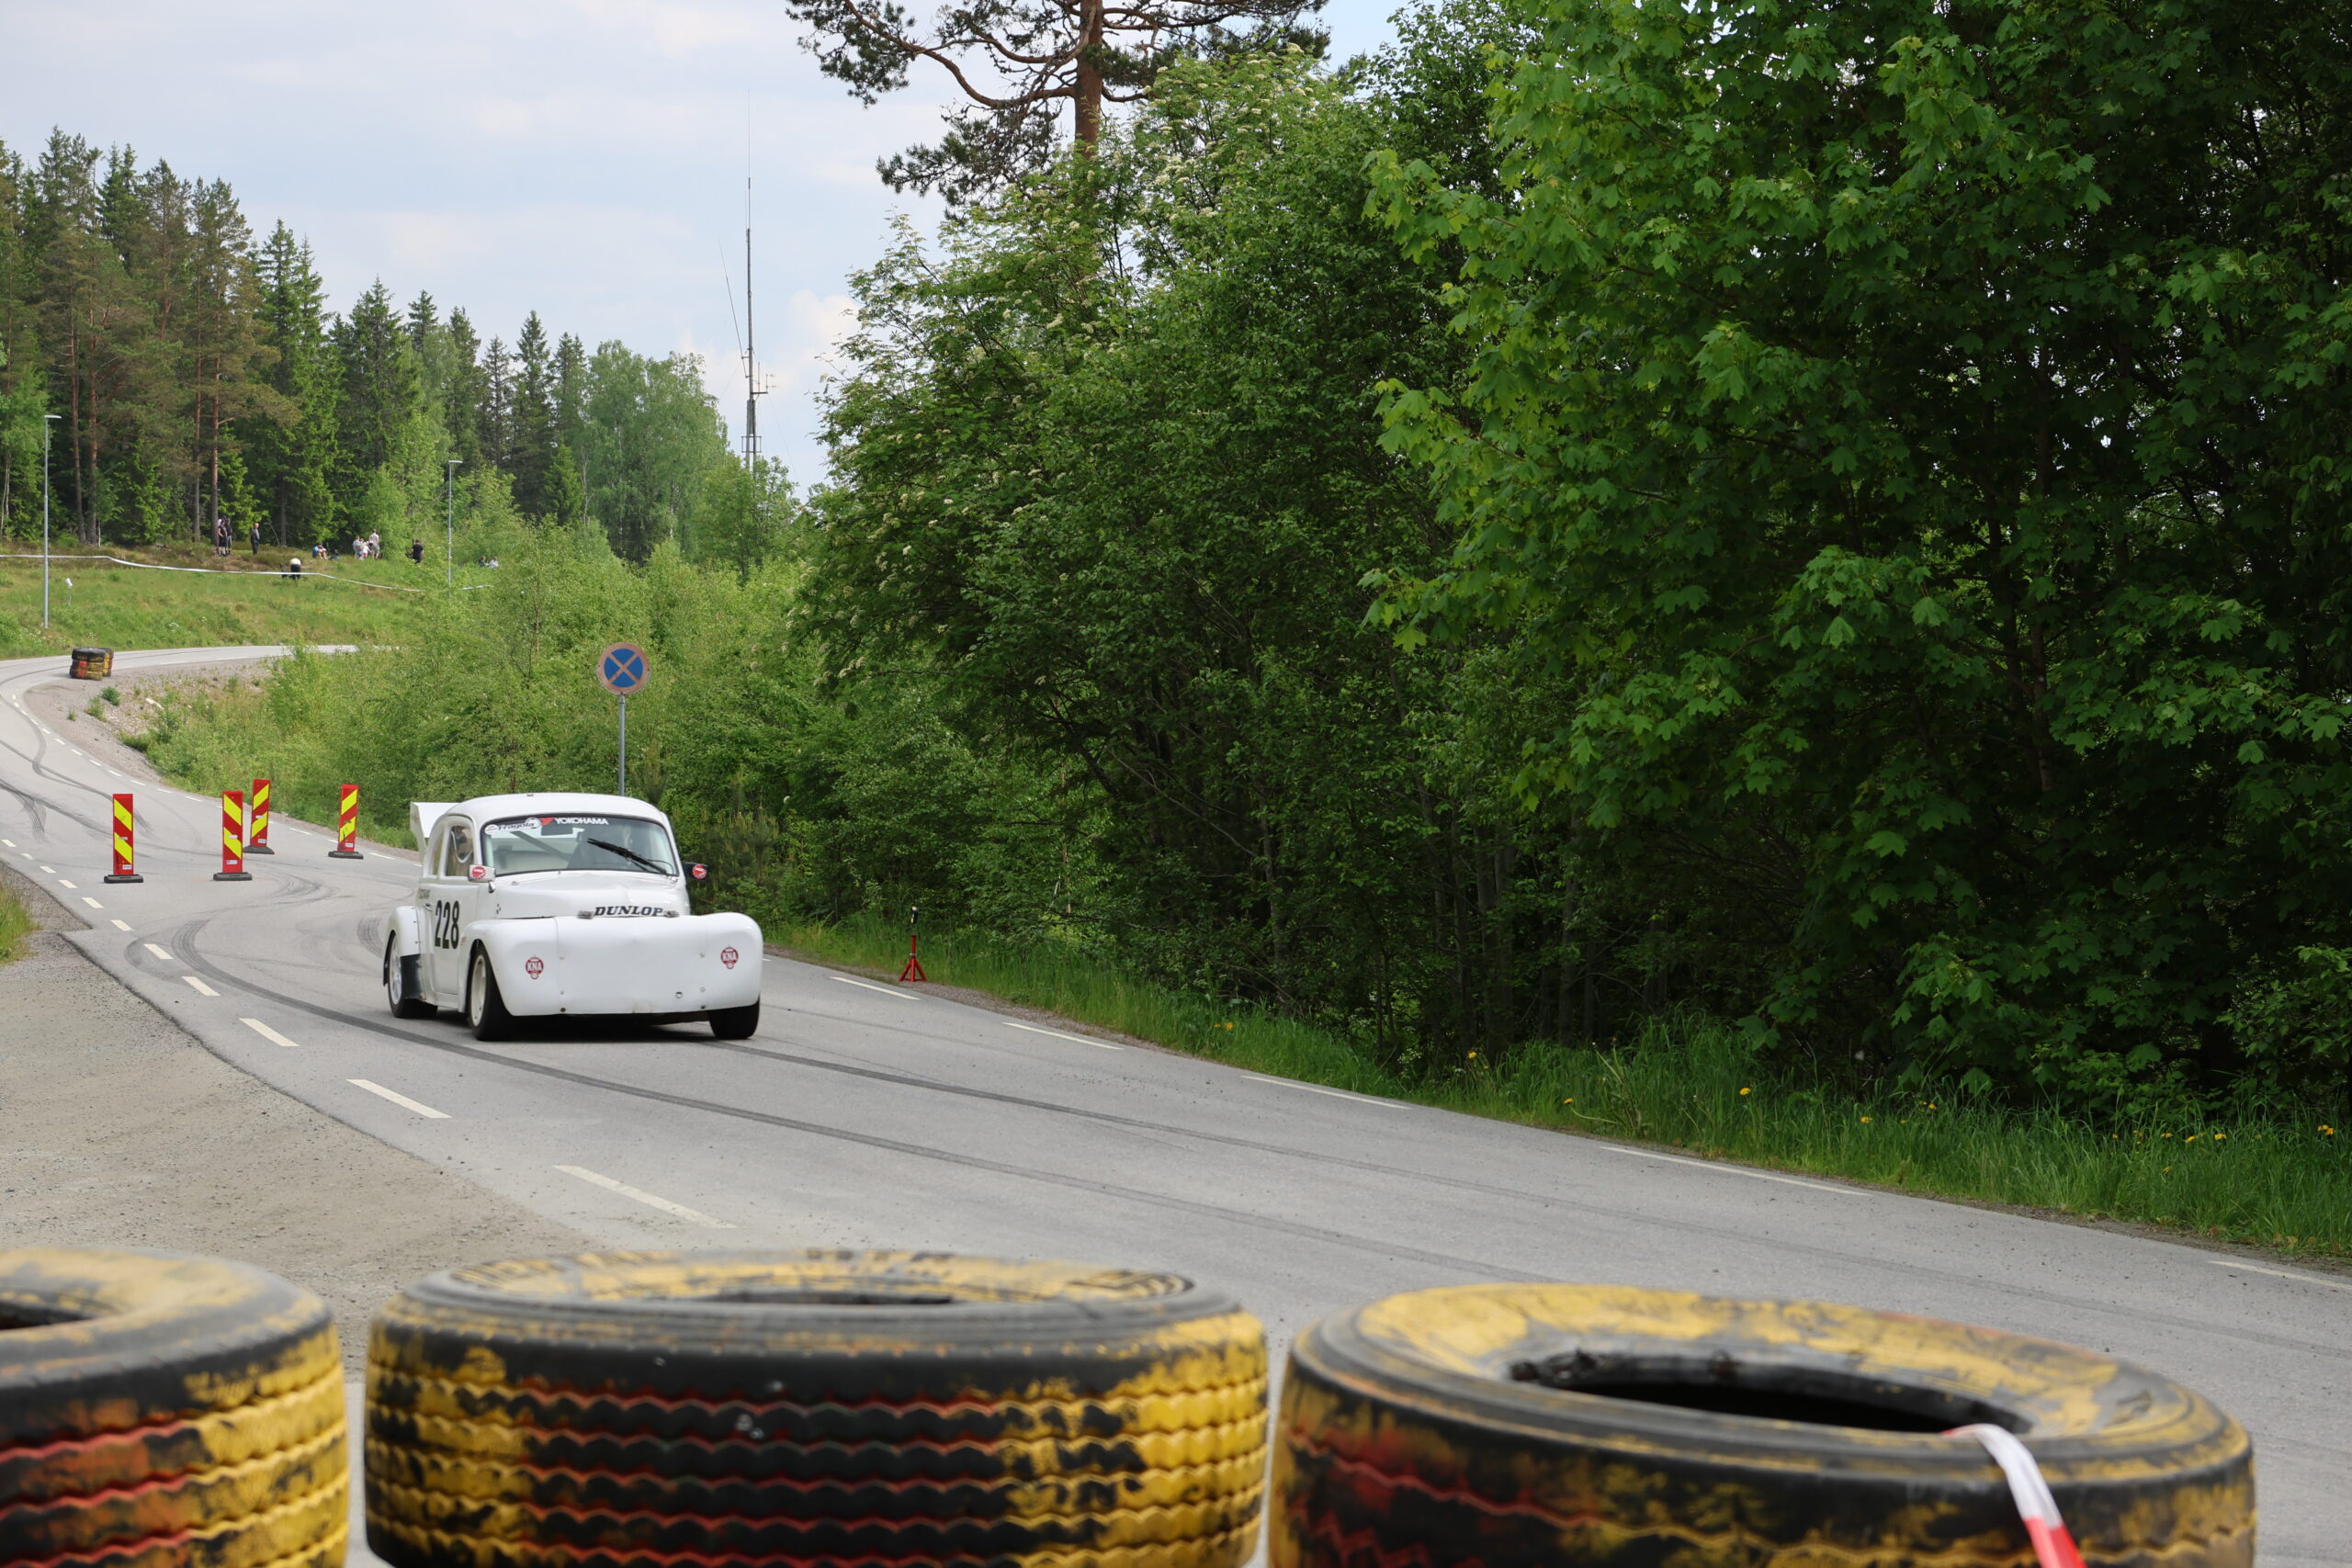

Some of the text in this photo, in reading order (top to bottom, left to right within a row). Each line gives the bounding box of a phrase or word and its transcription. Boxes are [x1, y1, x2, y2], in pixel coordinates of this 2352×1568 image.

[499, 821, 535, 830] Fragola
[554, 817, 609, 825] YOKOHAMA
[594, 905, 663, 917] DUNLOP
[435, 900, 460, 950] 228
[723, 952, 737, 962] KNA
[527, 962, 542, 971] KNA
